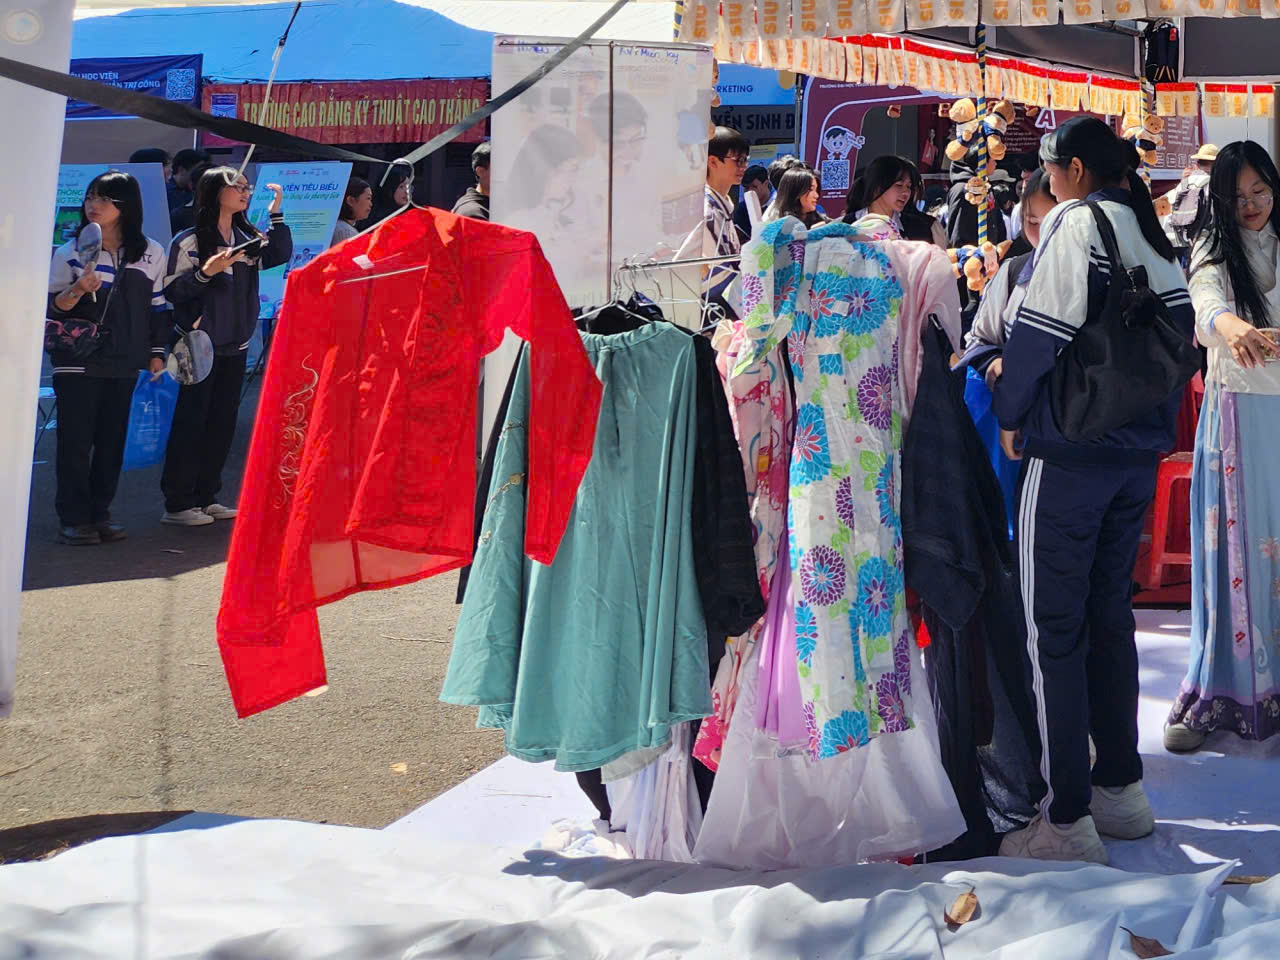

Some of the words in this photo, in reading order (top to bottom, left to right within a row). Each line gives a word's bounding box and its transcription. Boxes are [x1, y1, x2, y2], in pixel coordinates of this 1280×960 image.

[693, 5, 708, 39] SIU
[729, 3, 743, 37] SIU
[765, 1, 780, 35] SIU
[802, 0, 817, 33] SIU
[293, 102, 316, 127] CAO
[319, 88, 352, 127] ĐẲNG
[354, 95, 370, 126] KỸ
[373, 93, 410, 130] THUẬT
[413, 99, 437, 125] CAO
[746, 113, 782, 130] SINH
